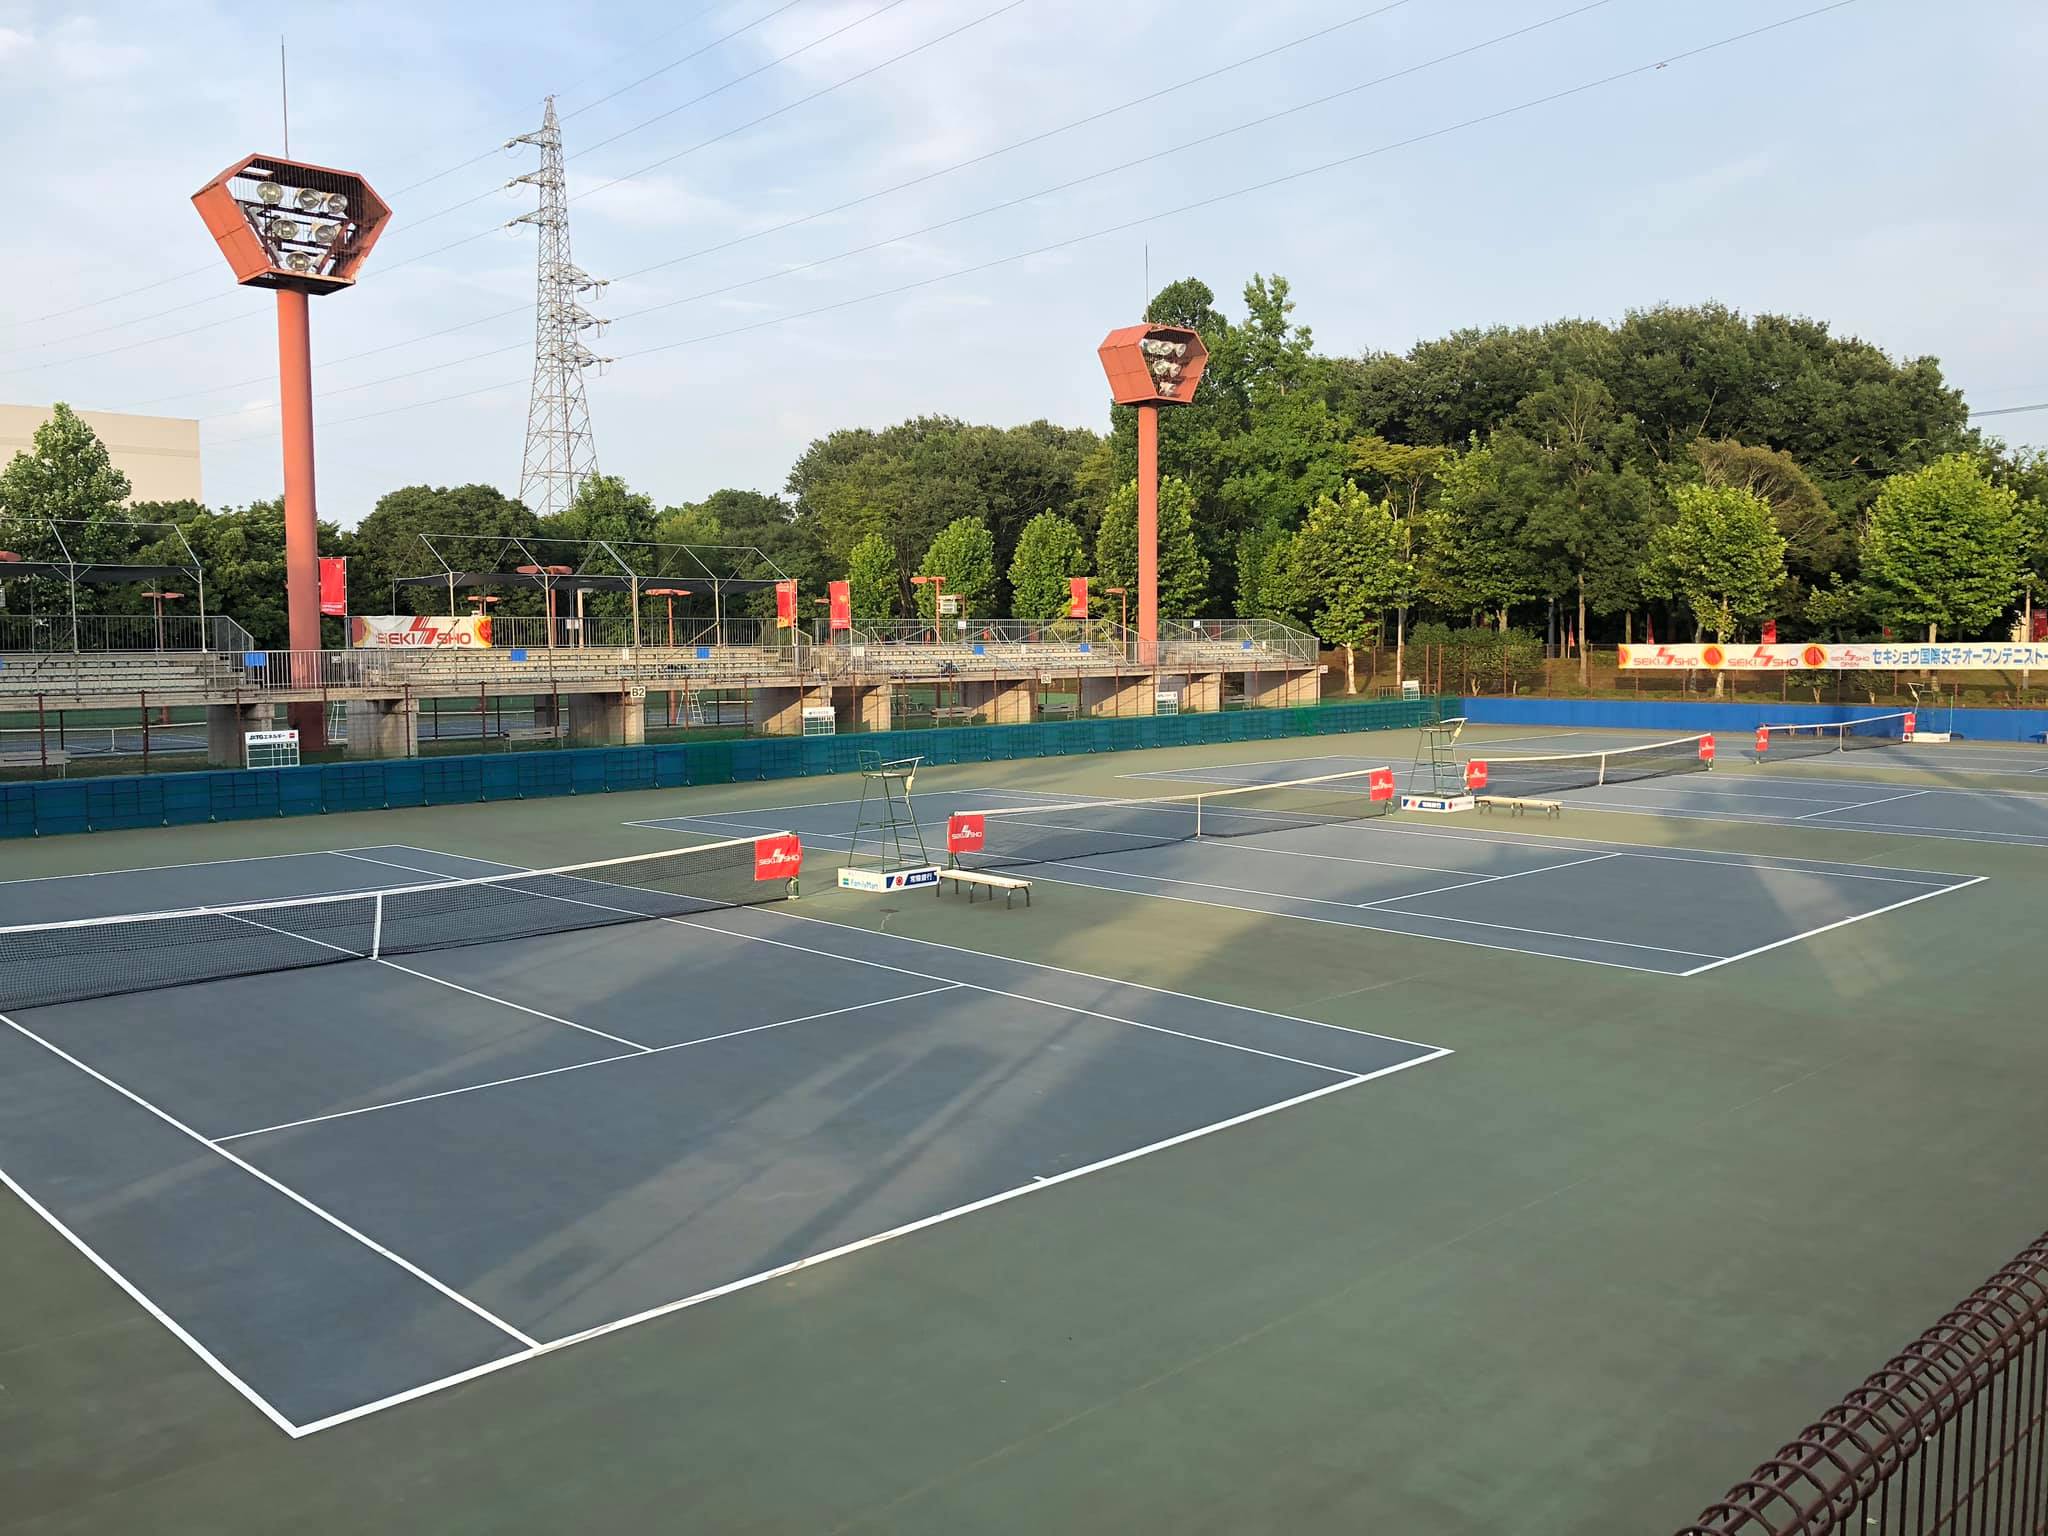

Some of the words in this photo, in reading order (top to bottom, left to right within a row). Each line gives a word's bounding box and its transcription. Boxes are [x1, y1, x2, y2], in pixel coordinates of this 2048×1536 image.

[376, 632, 415, 645] SEKI
[436, 632, 472, 645] SHO
[632, 687, 645, 697] B2
